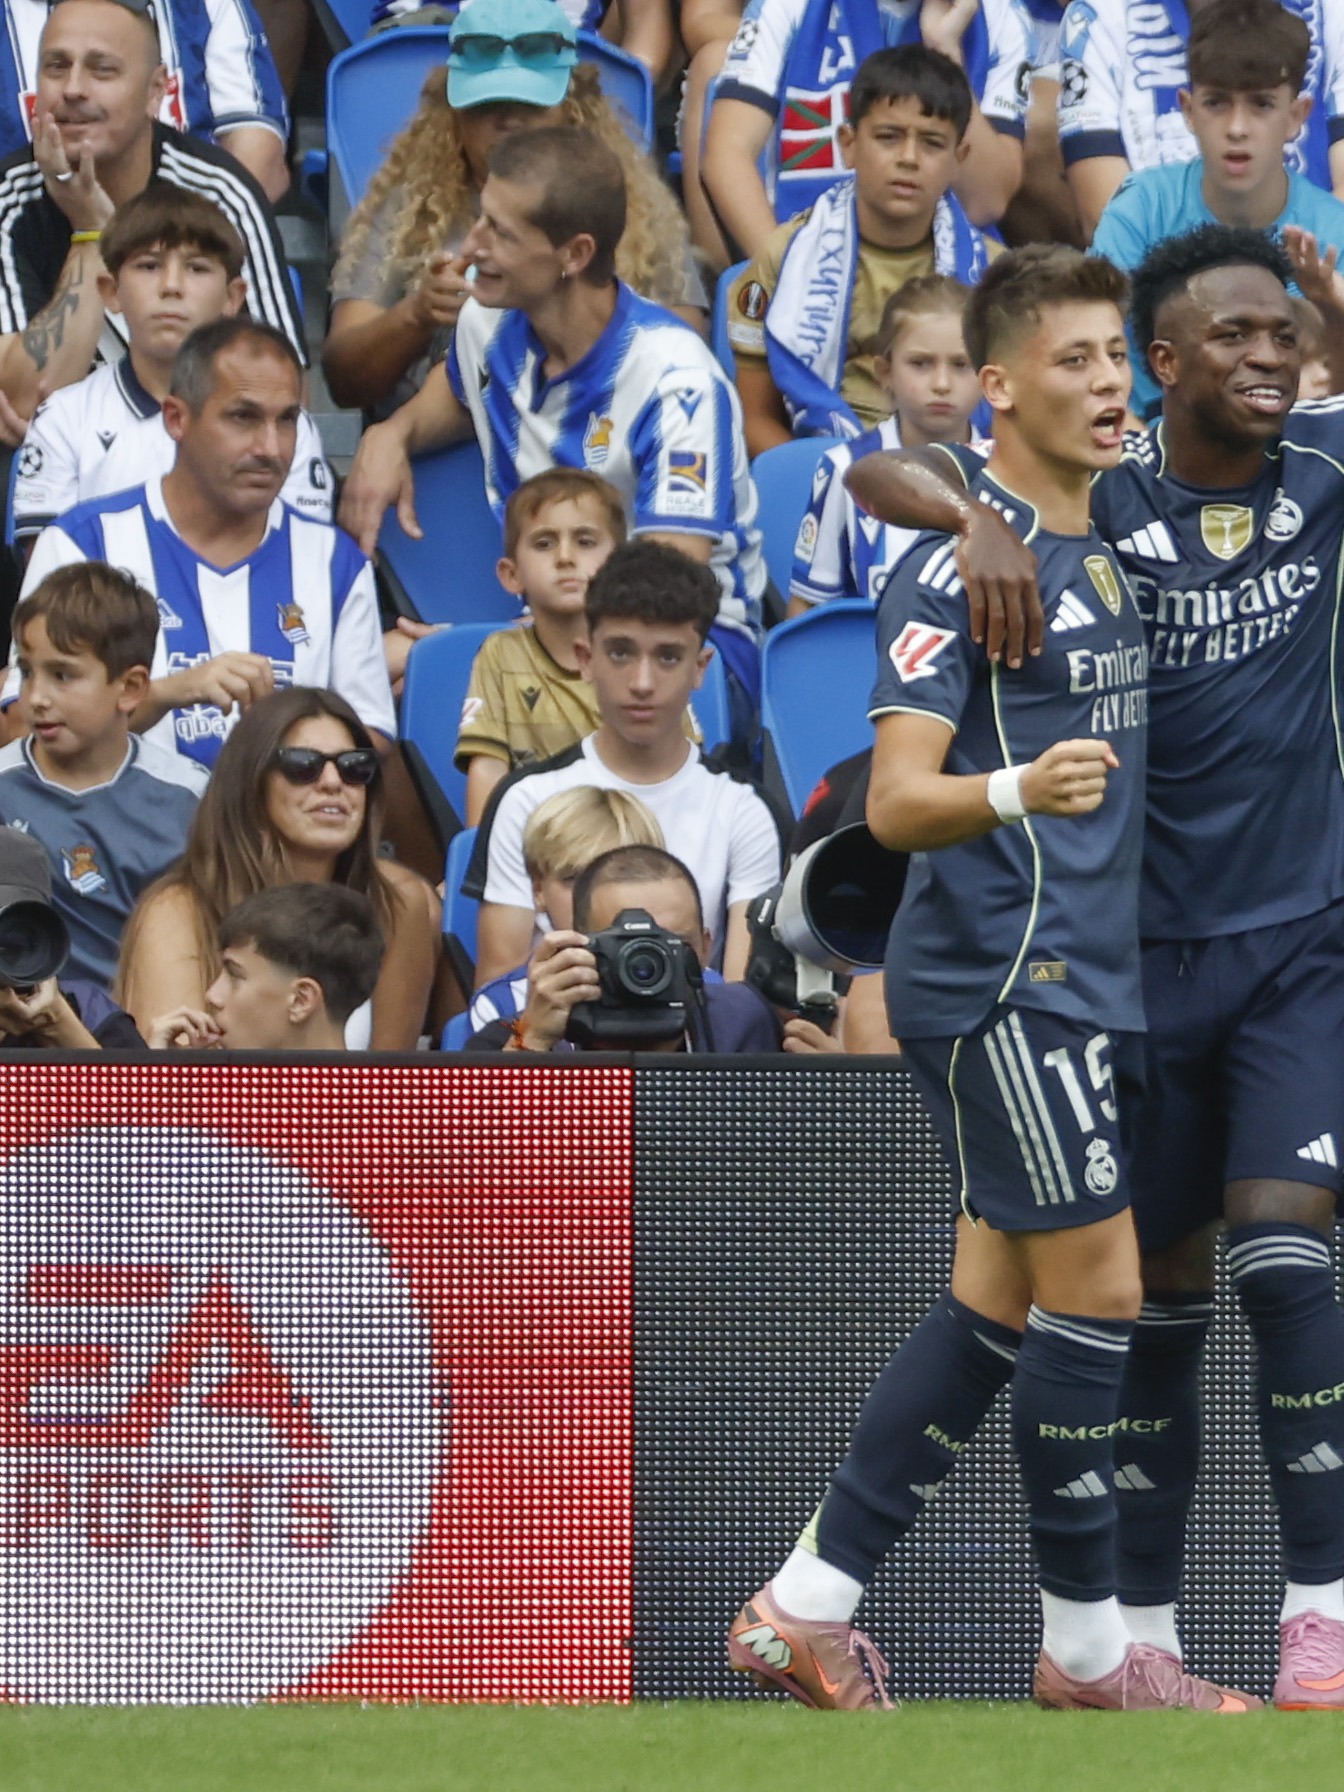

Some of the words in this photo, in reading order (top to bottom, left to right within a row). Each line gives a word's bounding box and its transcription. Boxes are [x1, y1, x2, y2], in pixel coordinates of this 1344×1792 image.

[1126, 562, 1321, 627] Emirates
[1151, 629, 1200, 667] FLY
[1205, 604, 1299, 663] BETTER
[1090, 693, 1120, 734] FLY
[1043, 1032, 1118, 1134] 15
